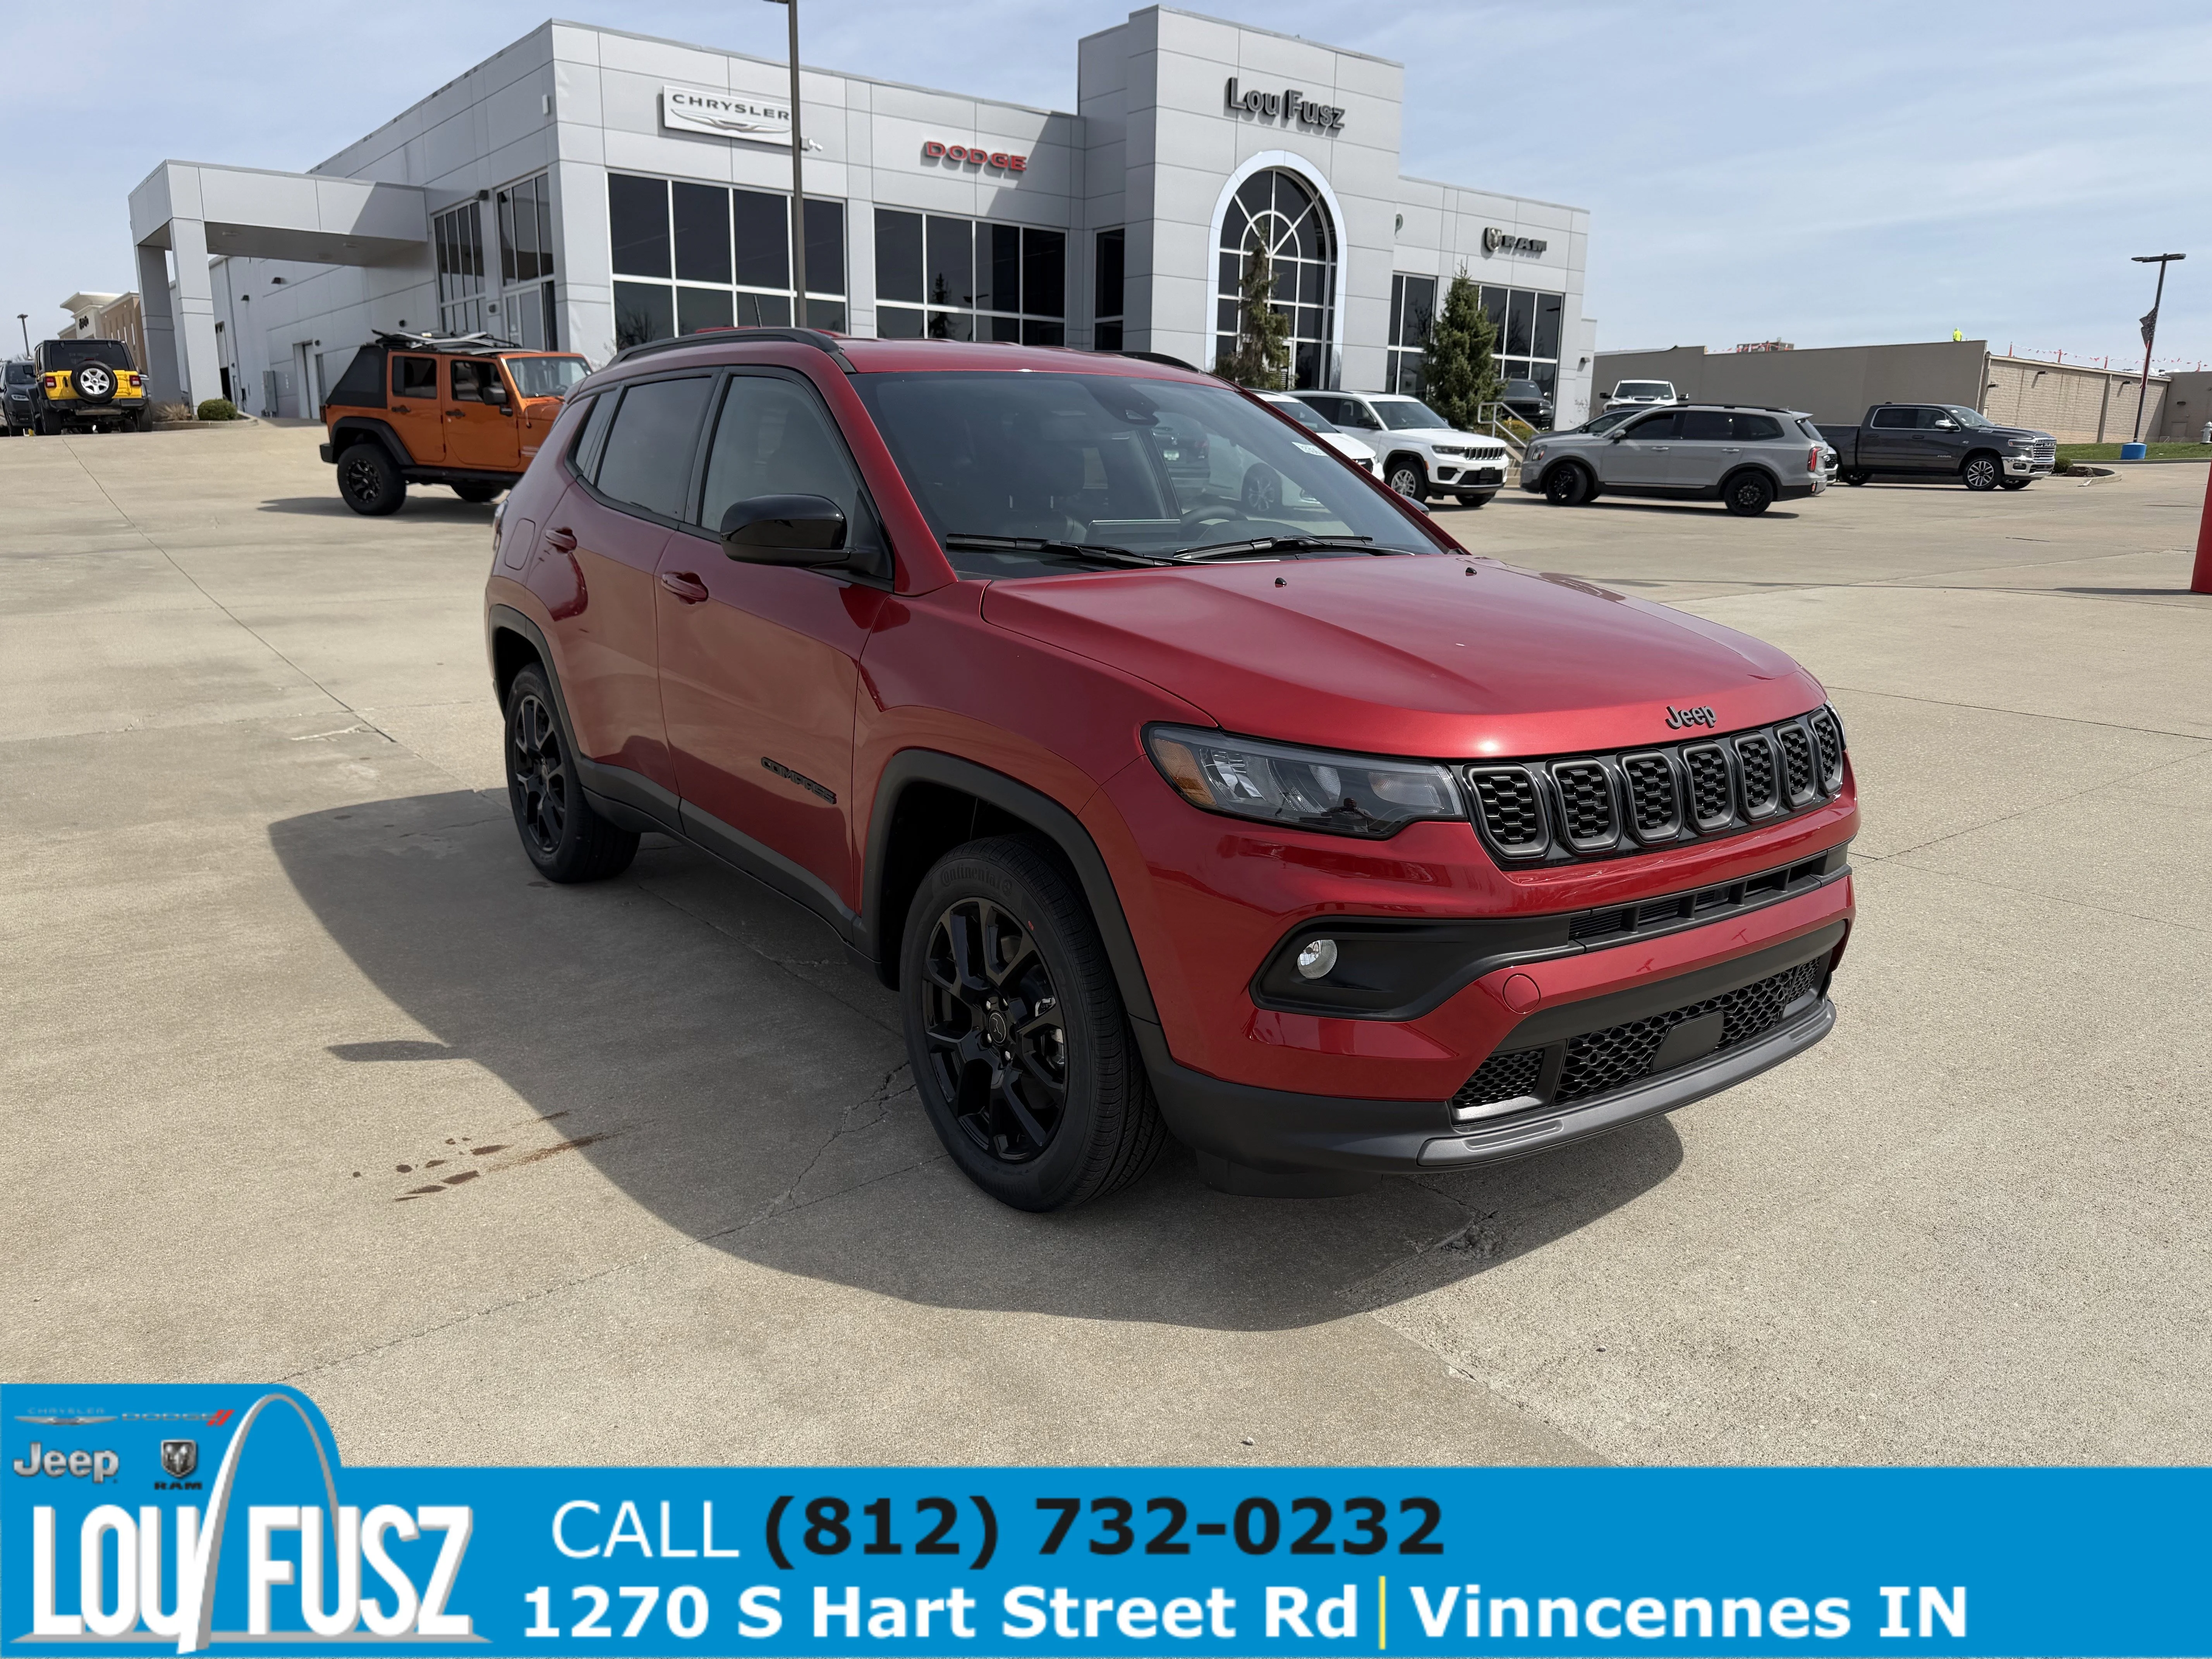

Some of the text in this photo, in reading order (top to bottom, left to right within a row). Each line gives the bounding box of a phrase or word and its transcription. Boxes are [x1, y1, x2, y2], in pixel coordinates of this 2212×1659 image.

[672, 93, 790, 120] CHRYSLER
[1230, 77, 1346, 129] Lou Fusz
[924, 141, 1027, 172] DODGE
[1502, 235, 1547, 252] RAM
[1665, 705, 1717, 730] Jeep
[761, 756, 837, 805] COMPASS
[940, 863, 1002, 891] Continental
